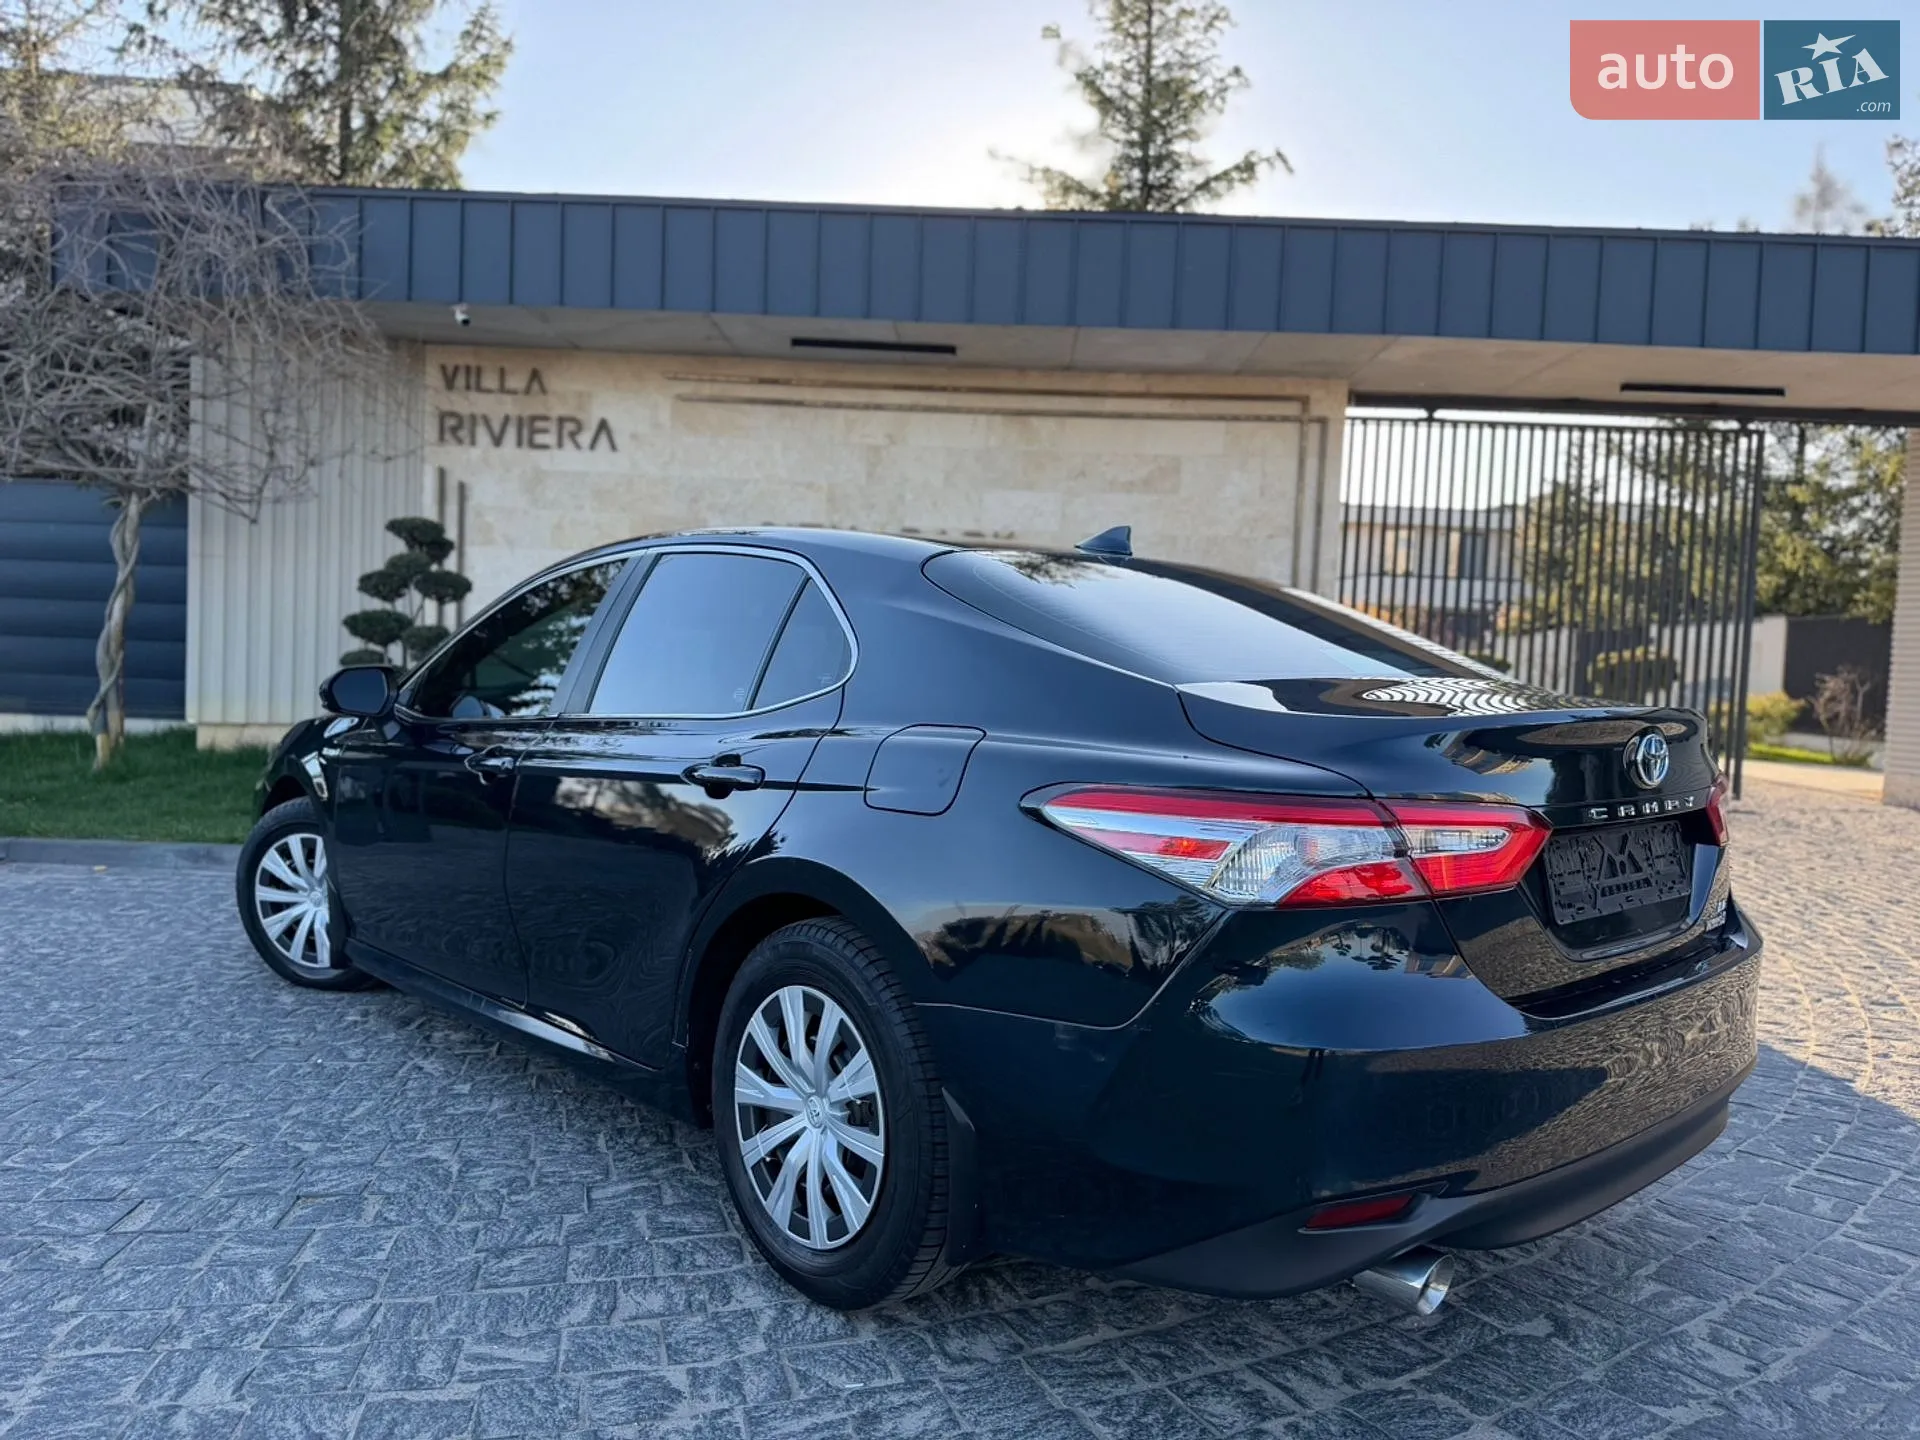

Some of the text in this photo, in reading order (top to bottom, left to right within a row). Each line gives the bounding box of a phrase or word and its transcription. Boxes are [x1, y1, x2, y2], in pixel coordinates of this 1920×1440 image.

[440, 363, 548, 396] VILLA
[437, 410, 619, 452] RIVIERA
[1588, 796, 1694, 819] CAMRY
